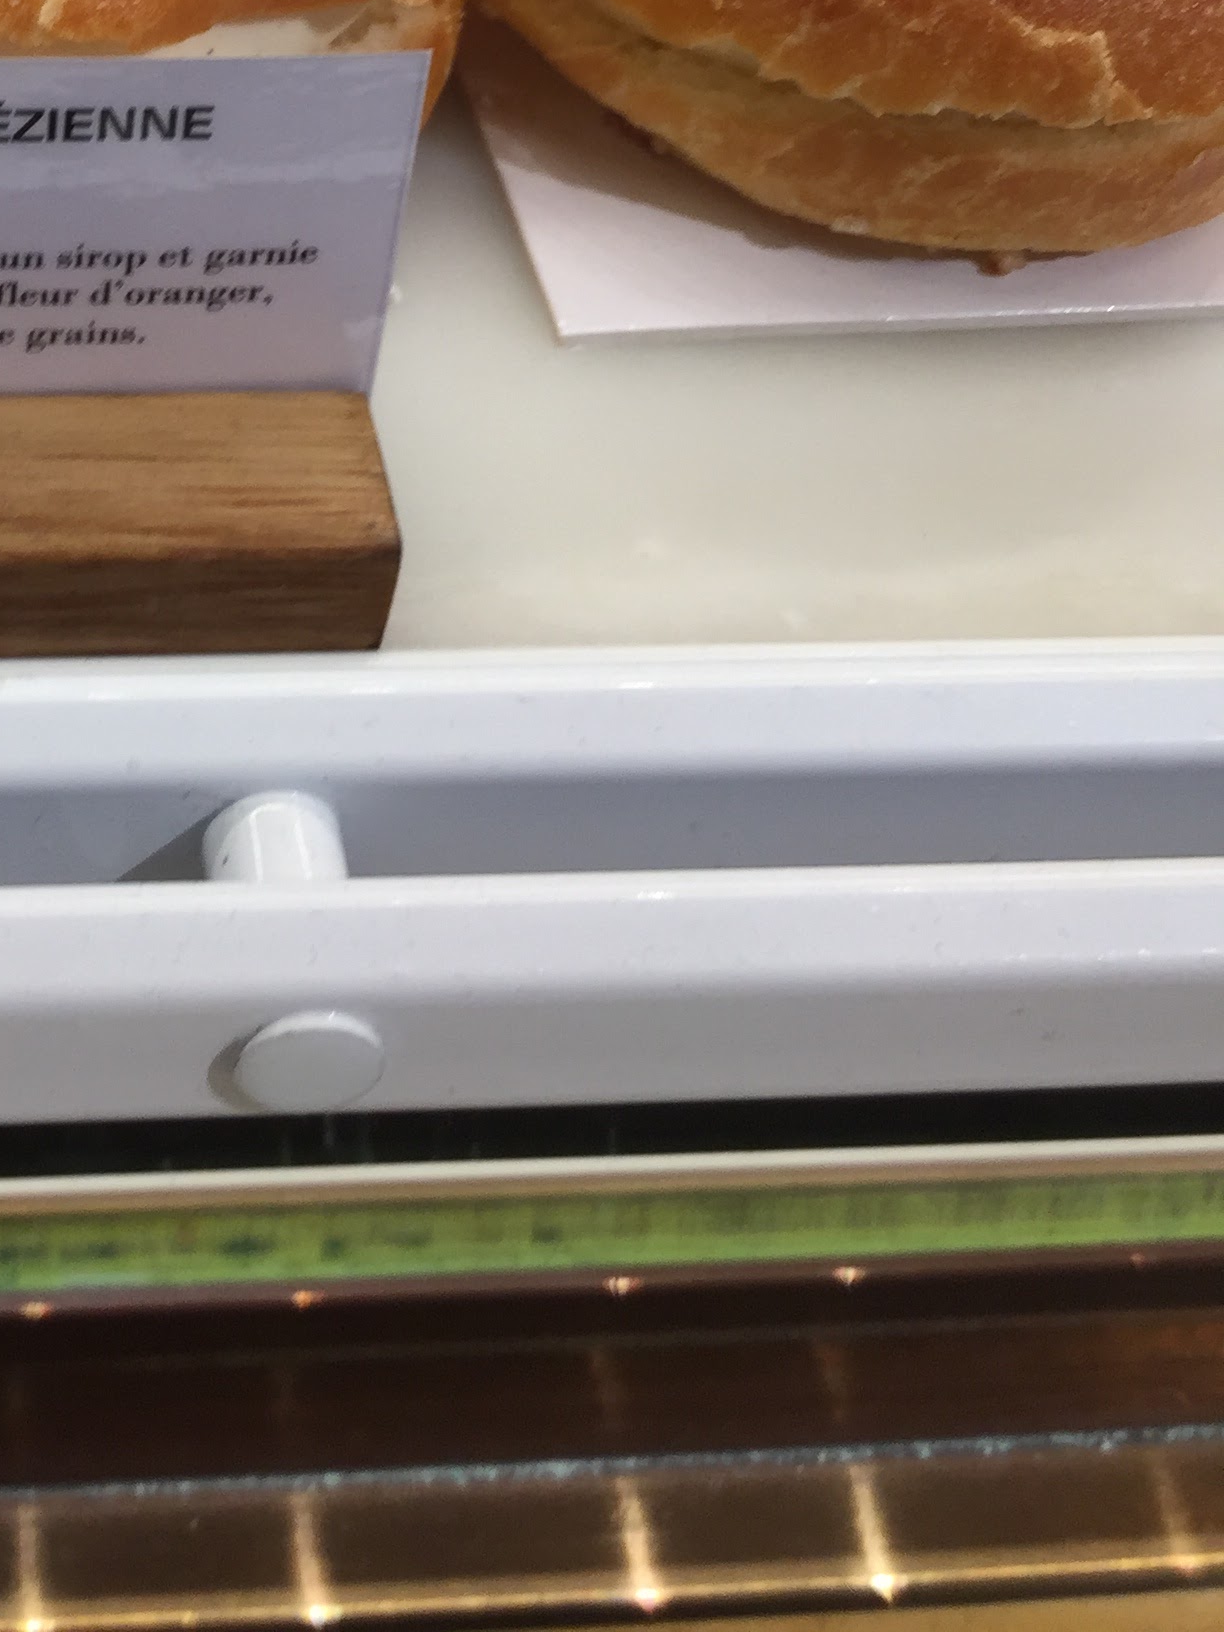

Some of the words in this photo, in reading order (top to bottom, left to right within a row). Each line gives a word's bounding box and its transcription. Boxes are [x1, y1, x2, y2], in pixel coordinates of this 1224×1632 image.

[56, 242, 147, 276] sirop
[158, 242, 192, 270] et
[203, 239, 318, 276] garnie
[89, 277, 273, 313] d'oranger,
[25, 320, 145, 354] grains.
